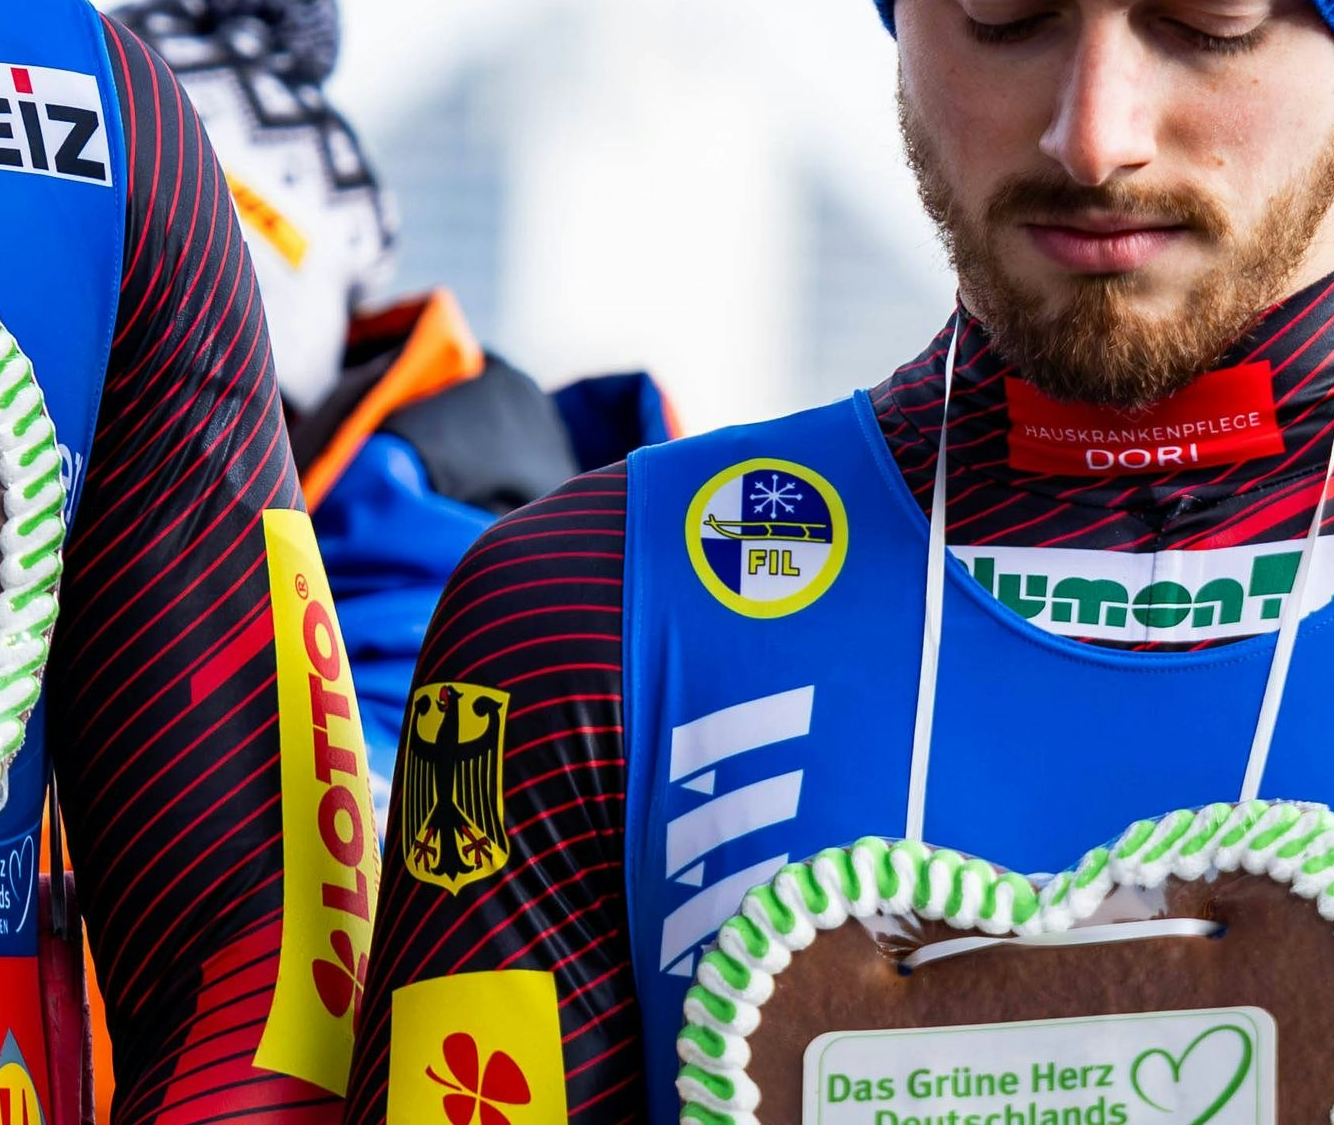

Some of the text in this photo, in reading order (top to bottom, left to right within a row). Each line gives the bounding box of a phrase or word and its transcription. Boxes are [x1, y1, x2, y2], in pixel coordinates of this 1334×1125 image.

[1024, 411, 1262, 444] HAUSKRANKENPFLEGE
[1085, 442, 1200, 471] DORI
[748, 549, 800, 576] FIL
[827, 1061, 1114, 1103] Das Grüne Herz
